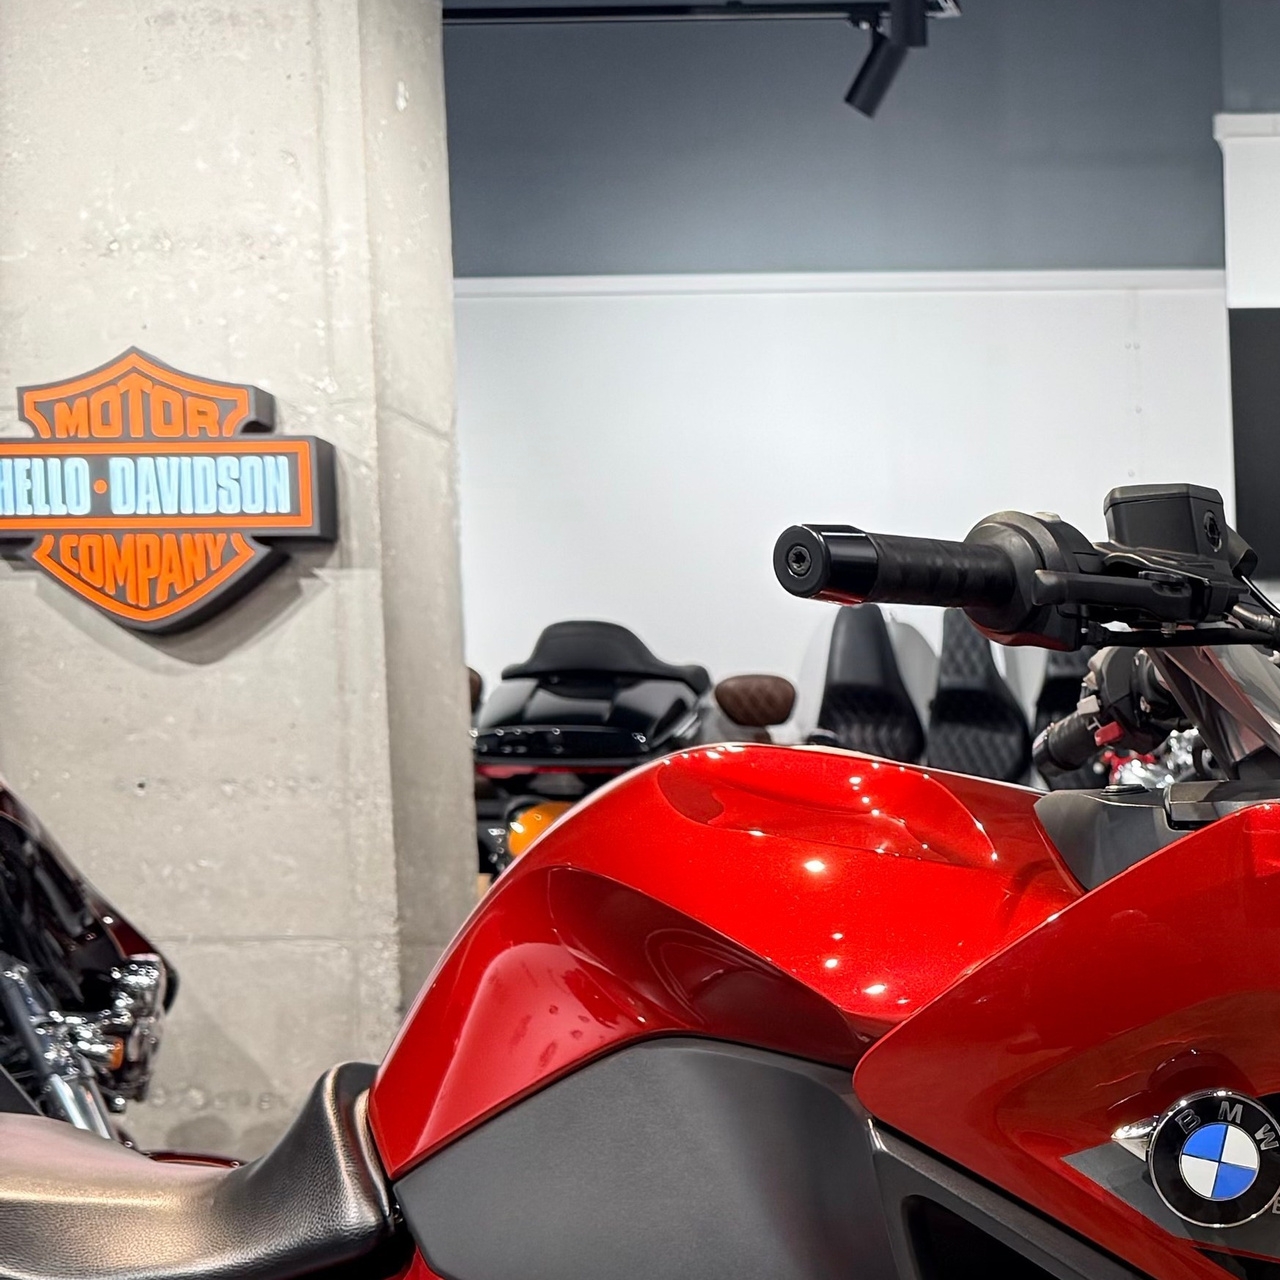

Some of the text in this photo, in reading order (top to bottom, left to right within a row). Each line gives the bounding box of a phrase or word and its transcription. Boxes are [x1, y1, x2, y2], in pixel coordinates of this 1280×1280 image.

[54, 372, 220, 438] MOTOR
[109, 456, 291, 515] DAVIDSON
[60, 533, 227, 607] COMPANY
[1175, 1100, 1280, 1150] BMW
